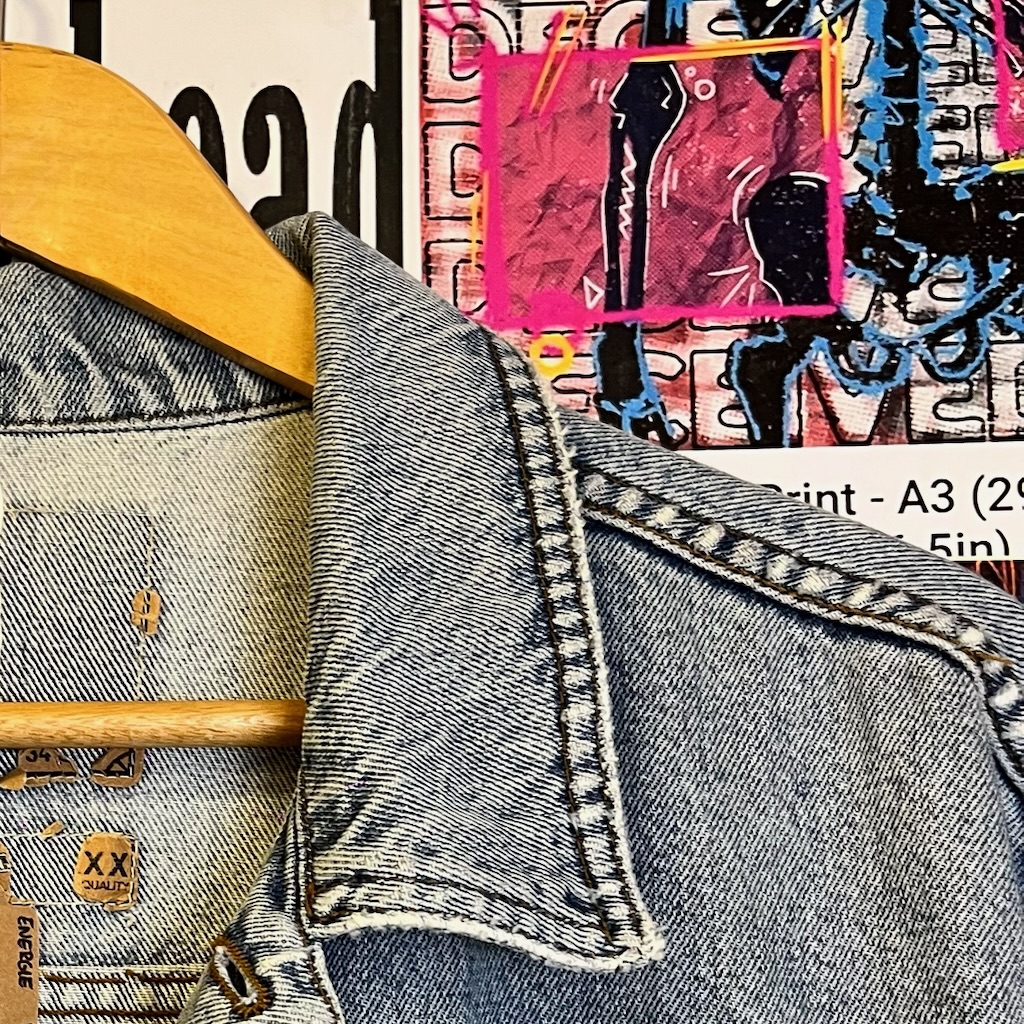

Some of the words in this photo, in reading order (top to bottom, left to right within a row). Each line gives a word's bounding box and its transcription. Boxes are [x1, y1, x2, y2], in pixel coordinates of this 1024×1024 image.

[761, 482, 856, 515] rint
[898, 478, 954, 513] A3
[972, 474, 1024, 521] (2
[17, 915, 35, 990] ENERGIE
